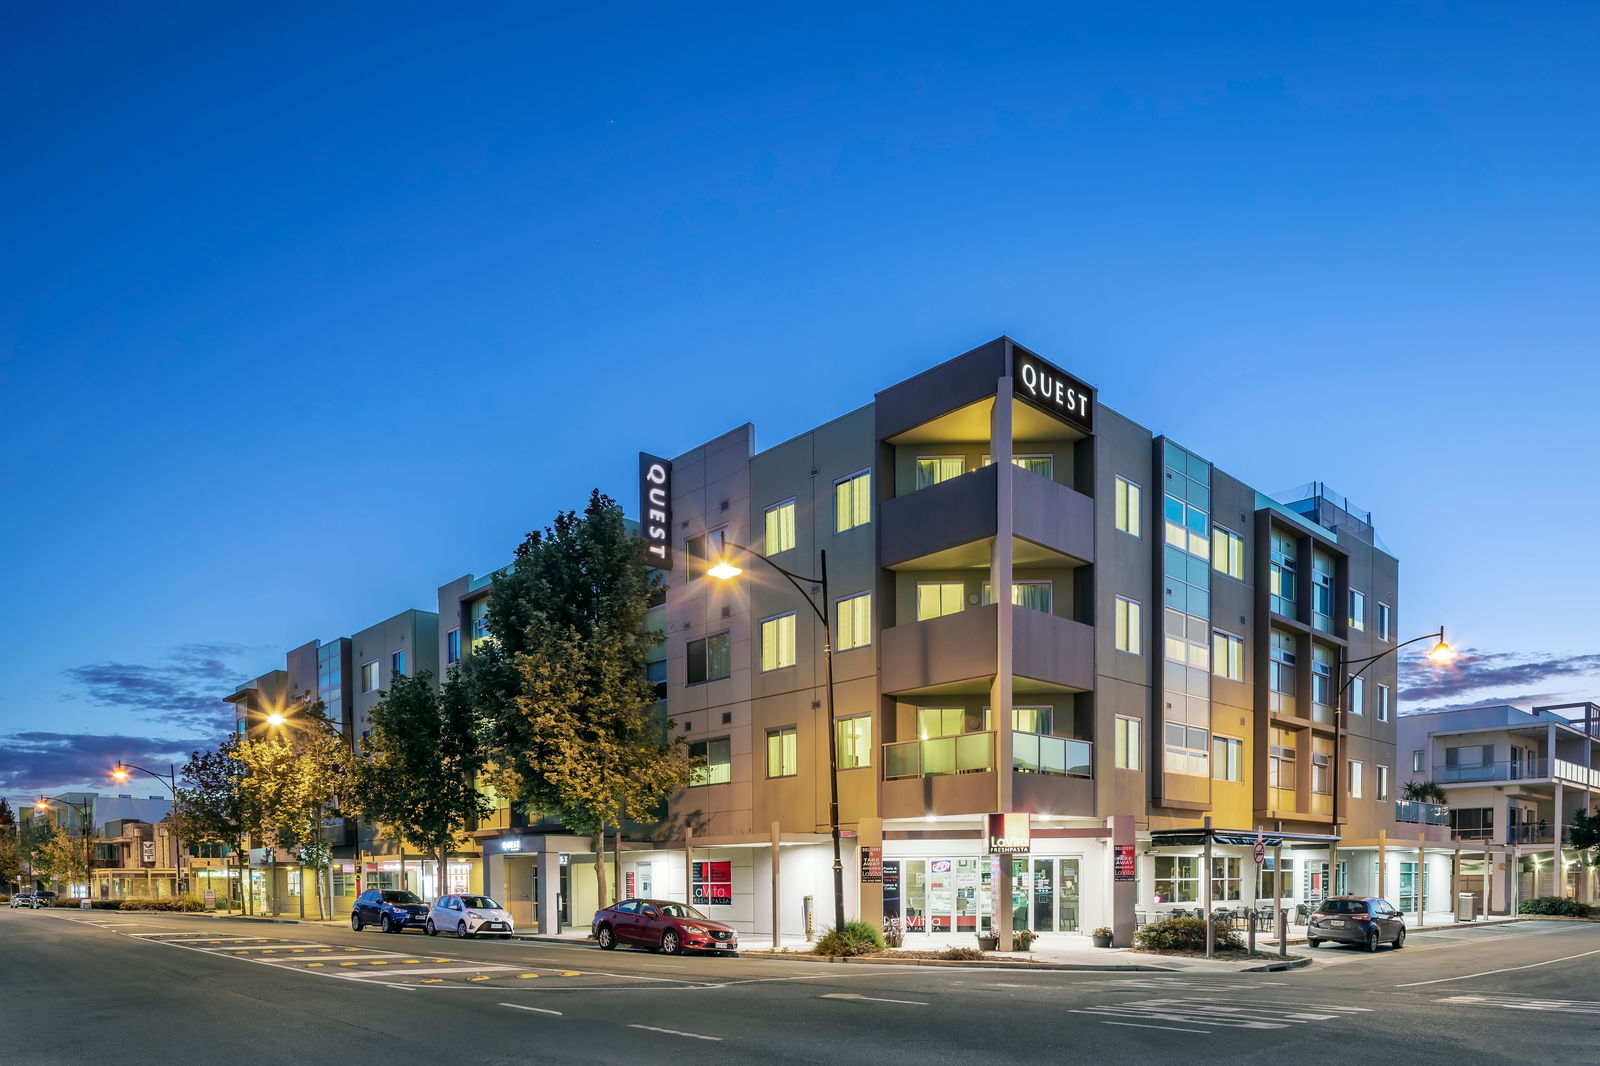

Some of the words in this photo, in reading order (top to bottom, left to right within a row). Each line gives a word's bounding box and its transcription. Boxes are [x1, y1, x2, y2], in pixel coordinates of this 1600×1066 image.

[1022, 363, 1088, 417] QUEST
[646, 464, 666, 559] QUEST
[502, 840, 520, 850] QUEST
[991, 836, 1029, 848] LaVita
[144, 843, 154, 859] VET
[932, 862, 950, 870] OPEN
